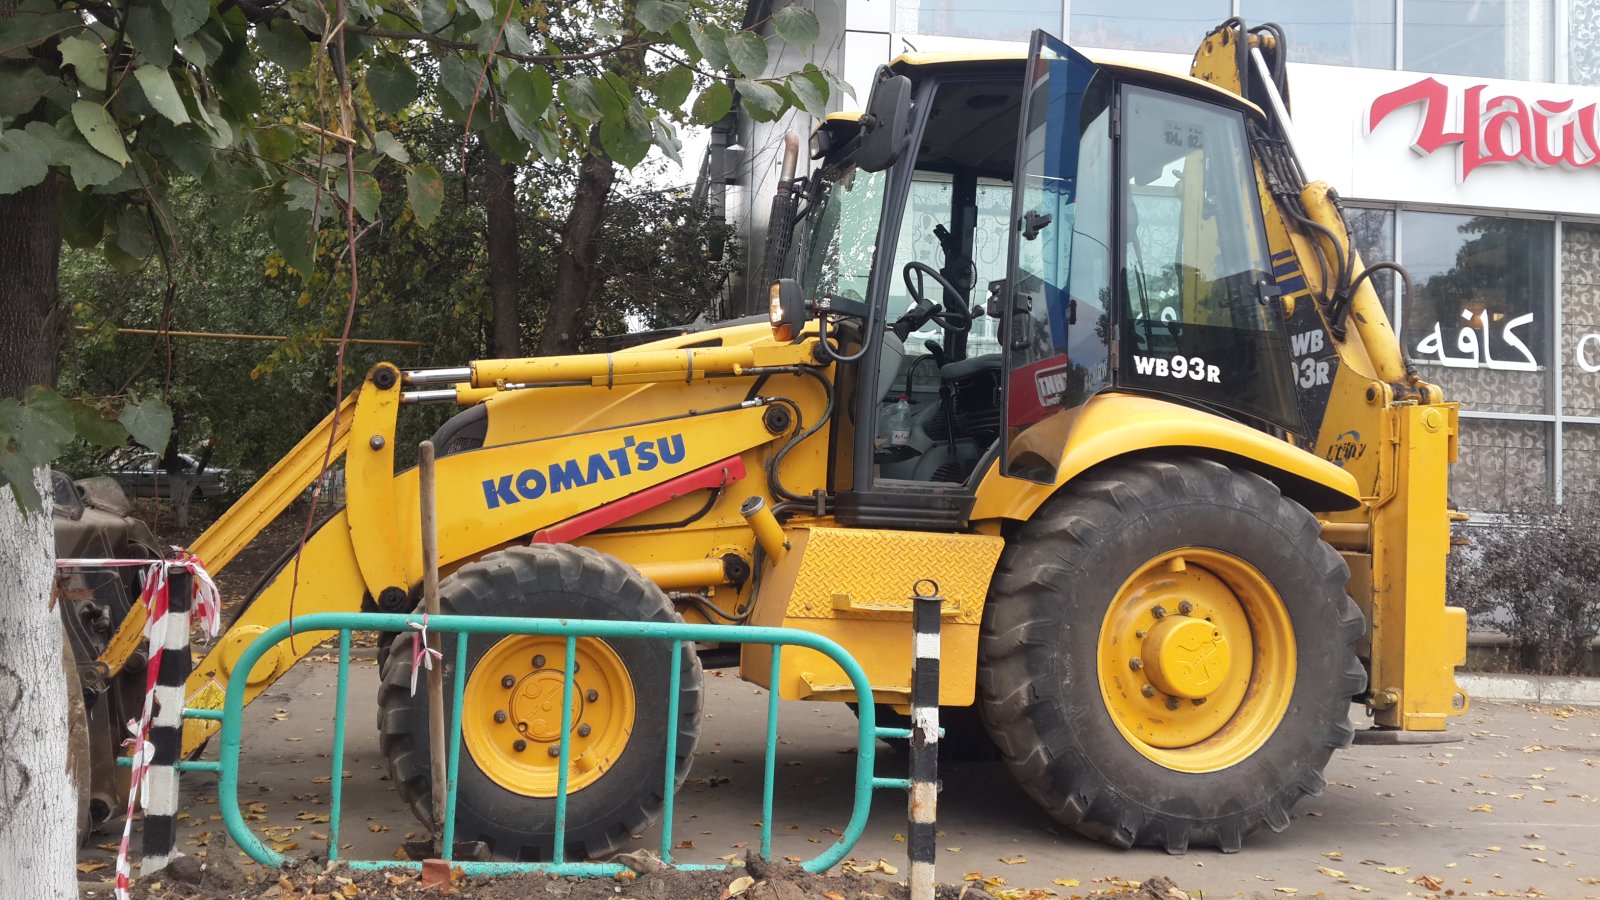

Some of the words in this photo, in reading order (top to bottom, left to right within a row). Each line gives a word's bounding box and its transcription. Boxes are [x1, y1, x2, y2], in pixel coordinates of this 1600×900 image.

[1291, 329, 1324, 357] WB
[1133, 355, 1221, 383] WB93R
[481, 433, 686, 510] KOMATSU
